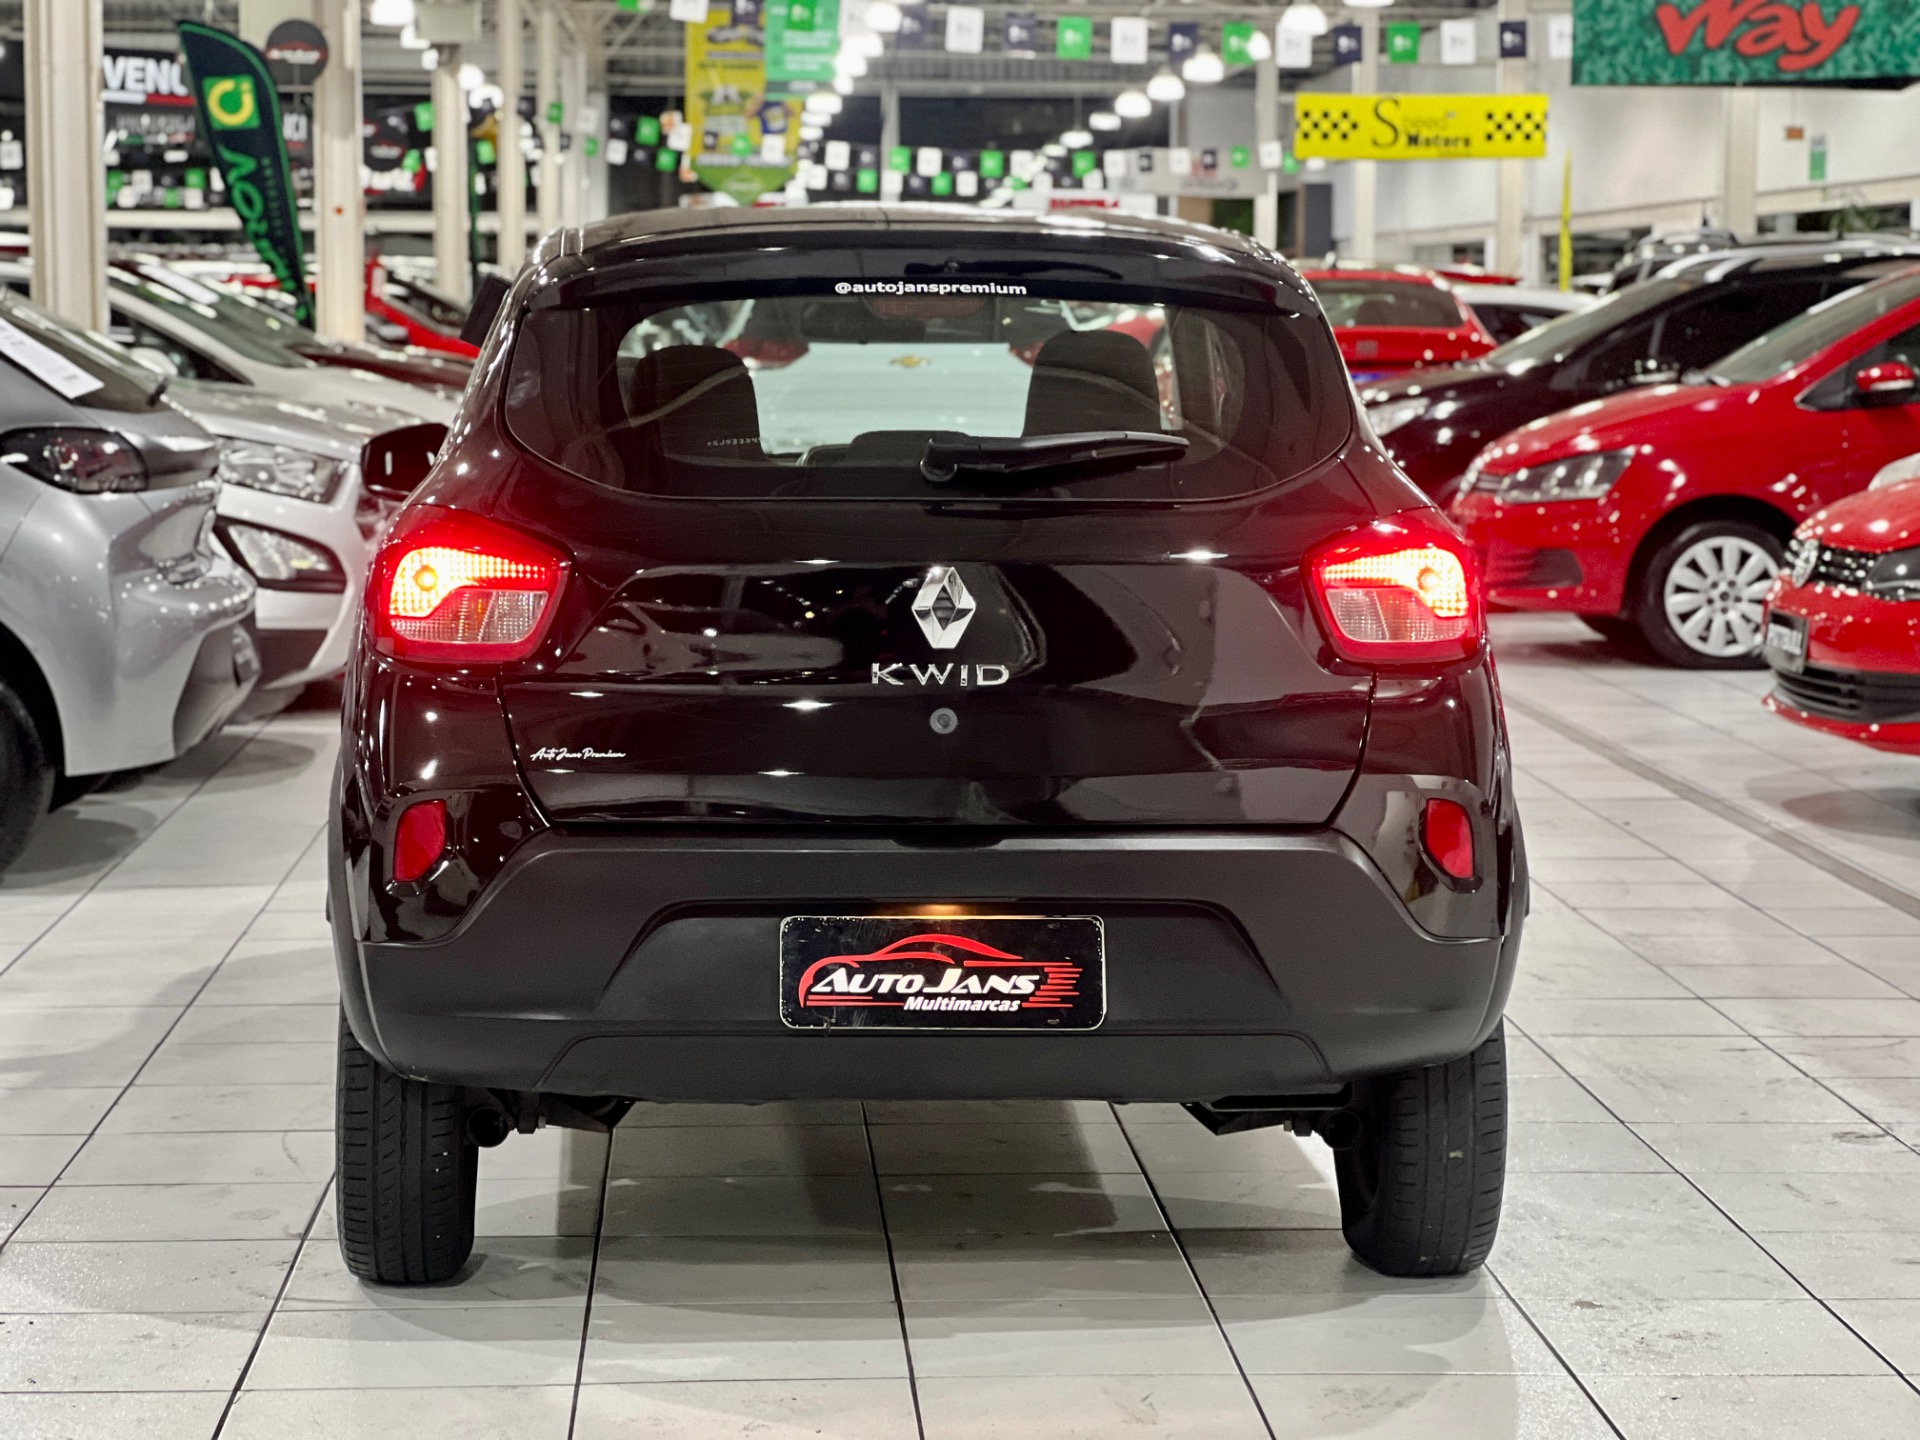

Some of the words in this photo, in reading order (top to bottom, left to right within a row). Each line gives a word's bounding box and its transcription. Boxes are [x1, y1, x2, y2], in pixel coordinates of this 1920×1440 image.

[834, 281, 1027, 295] @autojanspremium
[871, 662, 1010, 687] KWID
[903, 996, 1021, 1012] Multimarcas
